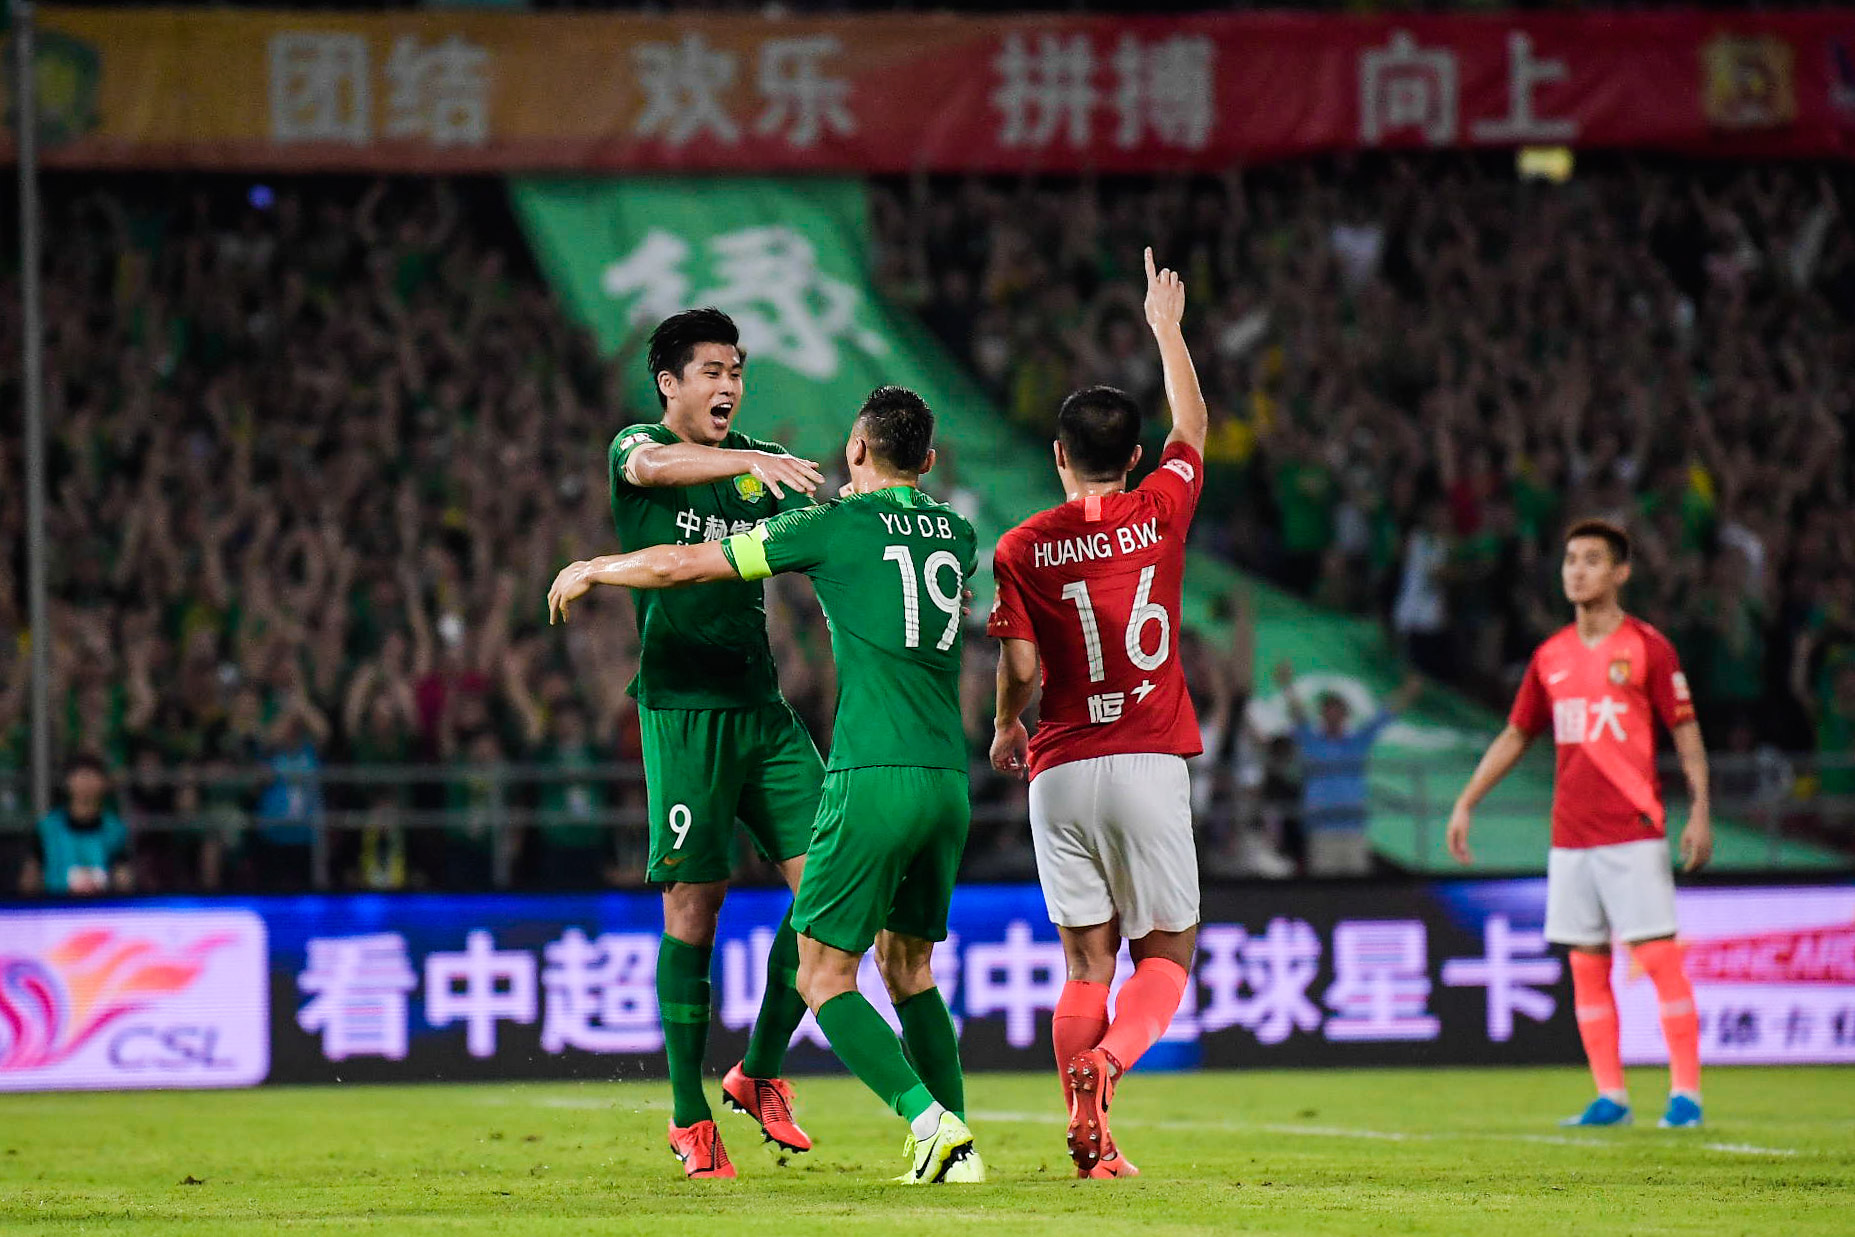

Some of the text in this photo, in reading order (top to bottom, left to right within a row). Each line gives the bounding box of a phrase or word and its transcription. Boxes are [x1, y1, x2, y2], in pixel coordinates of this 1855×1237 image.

[267, 29, 1581, 149] 团结 欢乐 拼搏 向上
[878, 512, 957, 541] YU D.B.
[1033, 516, 1163, 568] HUANG B.W.
[882, 545, 965, 652] 19
[1061, 564, 1170, 683] 16
[669, 804, 692, 850] 9
[296, 929, 664, 1062] 看中超
[107, 1025, 237, 1071] CSL
